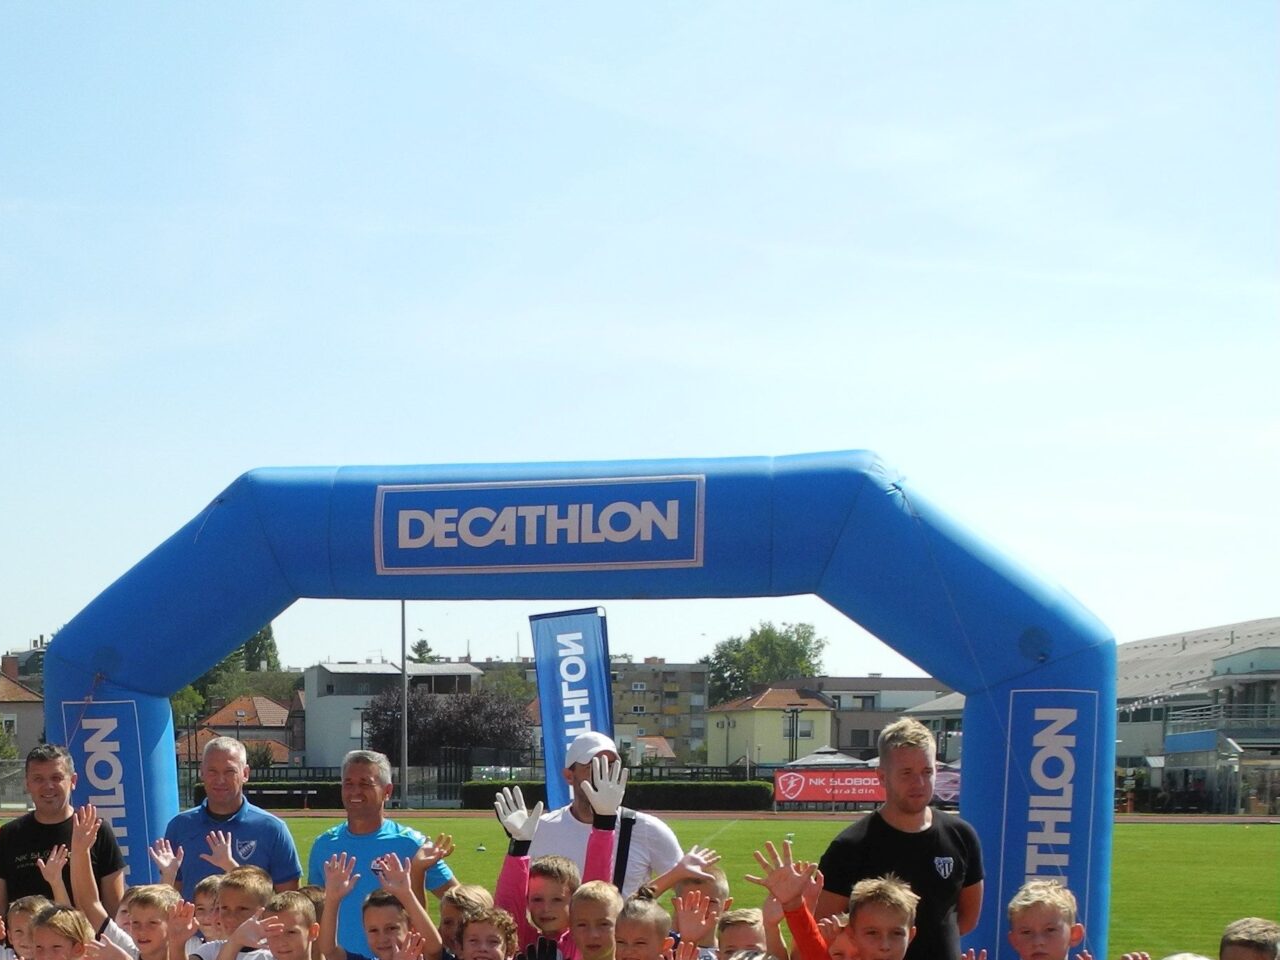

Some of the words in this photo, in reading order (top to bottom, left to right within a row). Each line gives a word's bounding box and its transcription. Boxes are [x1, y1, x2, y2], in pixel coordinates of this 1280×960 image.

[398, 500, 679, 548] DECATHLON
[809, 778, 826, 786] NK
[829, 777, 880, 786] SLOBOD
